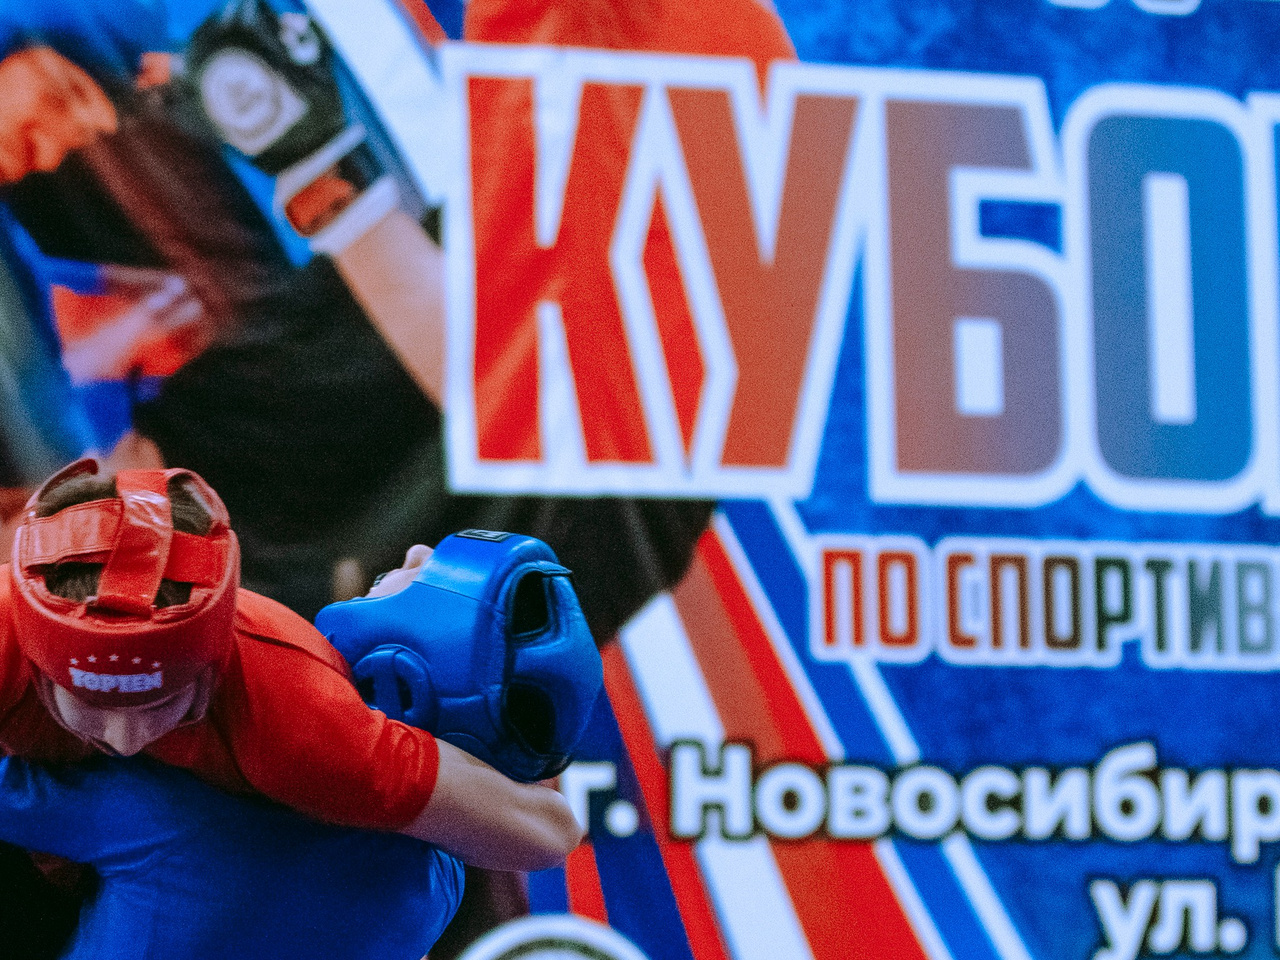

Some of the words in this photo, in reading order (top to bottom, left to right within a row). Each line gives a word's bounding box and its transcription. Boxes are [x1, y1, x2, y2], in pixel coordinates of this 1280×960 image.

[450, 54, 1280, 502] КУБО
[819, 546, 922, 651] ПО
[945, 549, 1280, 656] СПОРТИВ
[562, 758, 641, 838] г.
[668, 740, 1280, 864] Новосибир
